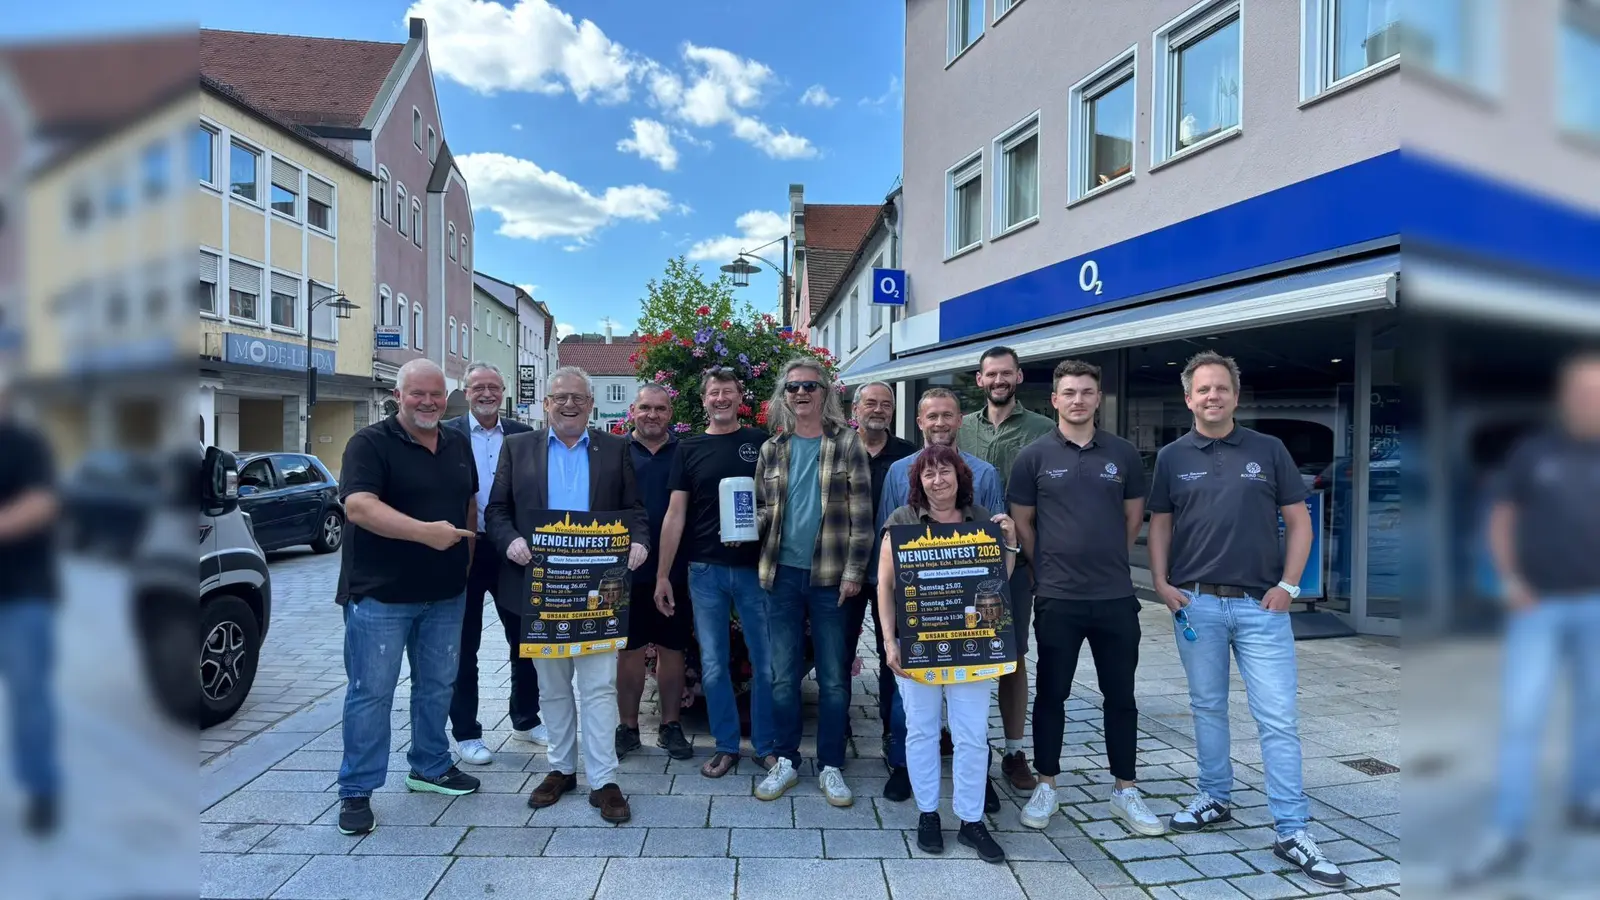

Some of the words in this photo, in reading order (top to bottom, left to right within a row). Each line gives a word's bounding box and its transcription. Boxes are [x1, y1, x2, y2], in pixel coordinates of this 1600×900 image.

[1079, 260, 1103, 296] O2
[880, 277, 900, 298] O2
[532, 534, 610, 548] WENDELINFEST
[611, 535, 630, 547] 2026
[898, 546, 976, 563] WENDELINFEST
[977, 545, 1000, 557] 2026
[547, 568, 572, 576] Samstag
